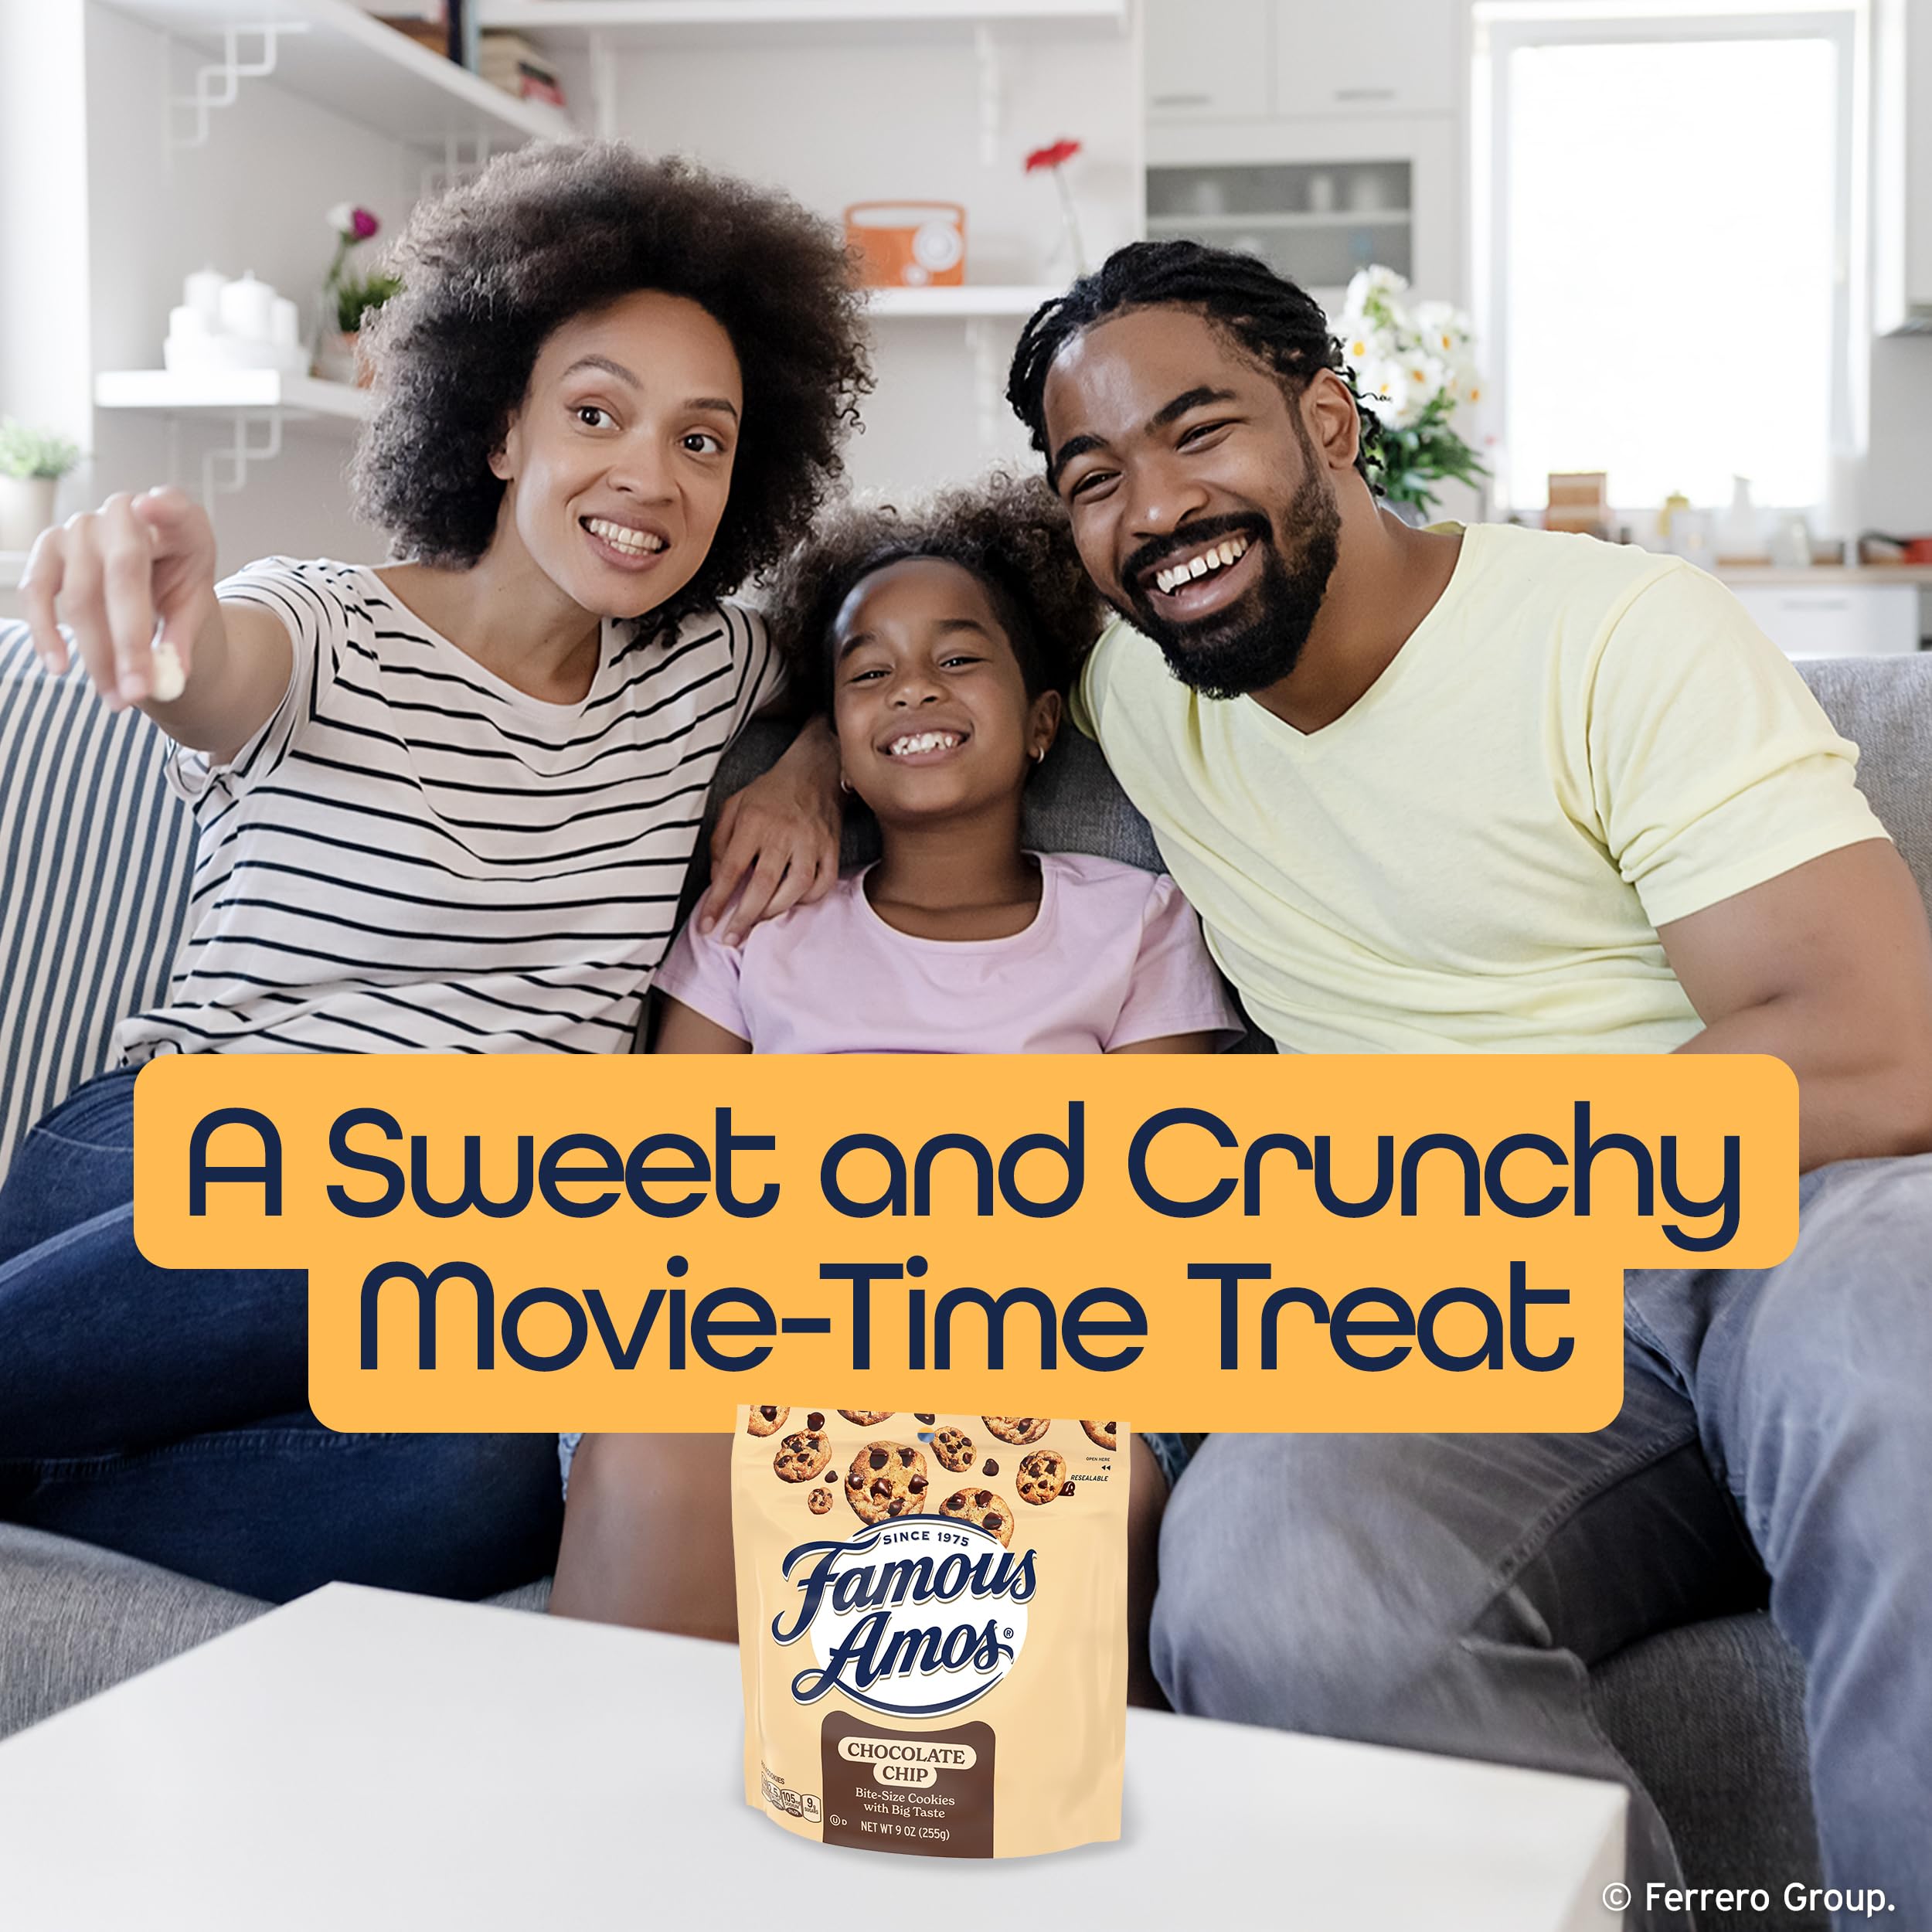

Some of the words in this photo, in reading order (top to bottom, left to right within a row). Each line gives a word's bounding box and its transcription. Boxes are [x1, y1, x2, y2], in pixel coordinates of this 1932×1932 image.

[883, 1531, 930, 1545] SINCE
[937, 1532, 969, 1546] 1975
[772, 1532, 1036, 1644] Famous
[847, 1743, 965, 1764] CHOCOLATE
[883, 1766, 929, 1782] CHIP
[855, 1787, 906, 1803] Bite-Size
[908, 1793, 955, 1806] Cookies
[864, 1802, 889, 1814] with
[892, 1804, 910, 1817] Big
[913, 1807, 946, 1818] Taste
[861, 1821, 878, 1833] NET
[879, 1823, 893, 1835] WT
[895, 1825, 903, 1835] 9
[904, 1825, 917, 1837] OZ
[918, 1827, 951, 1842] (255g)
